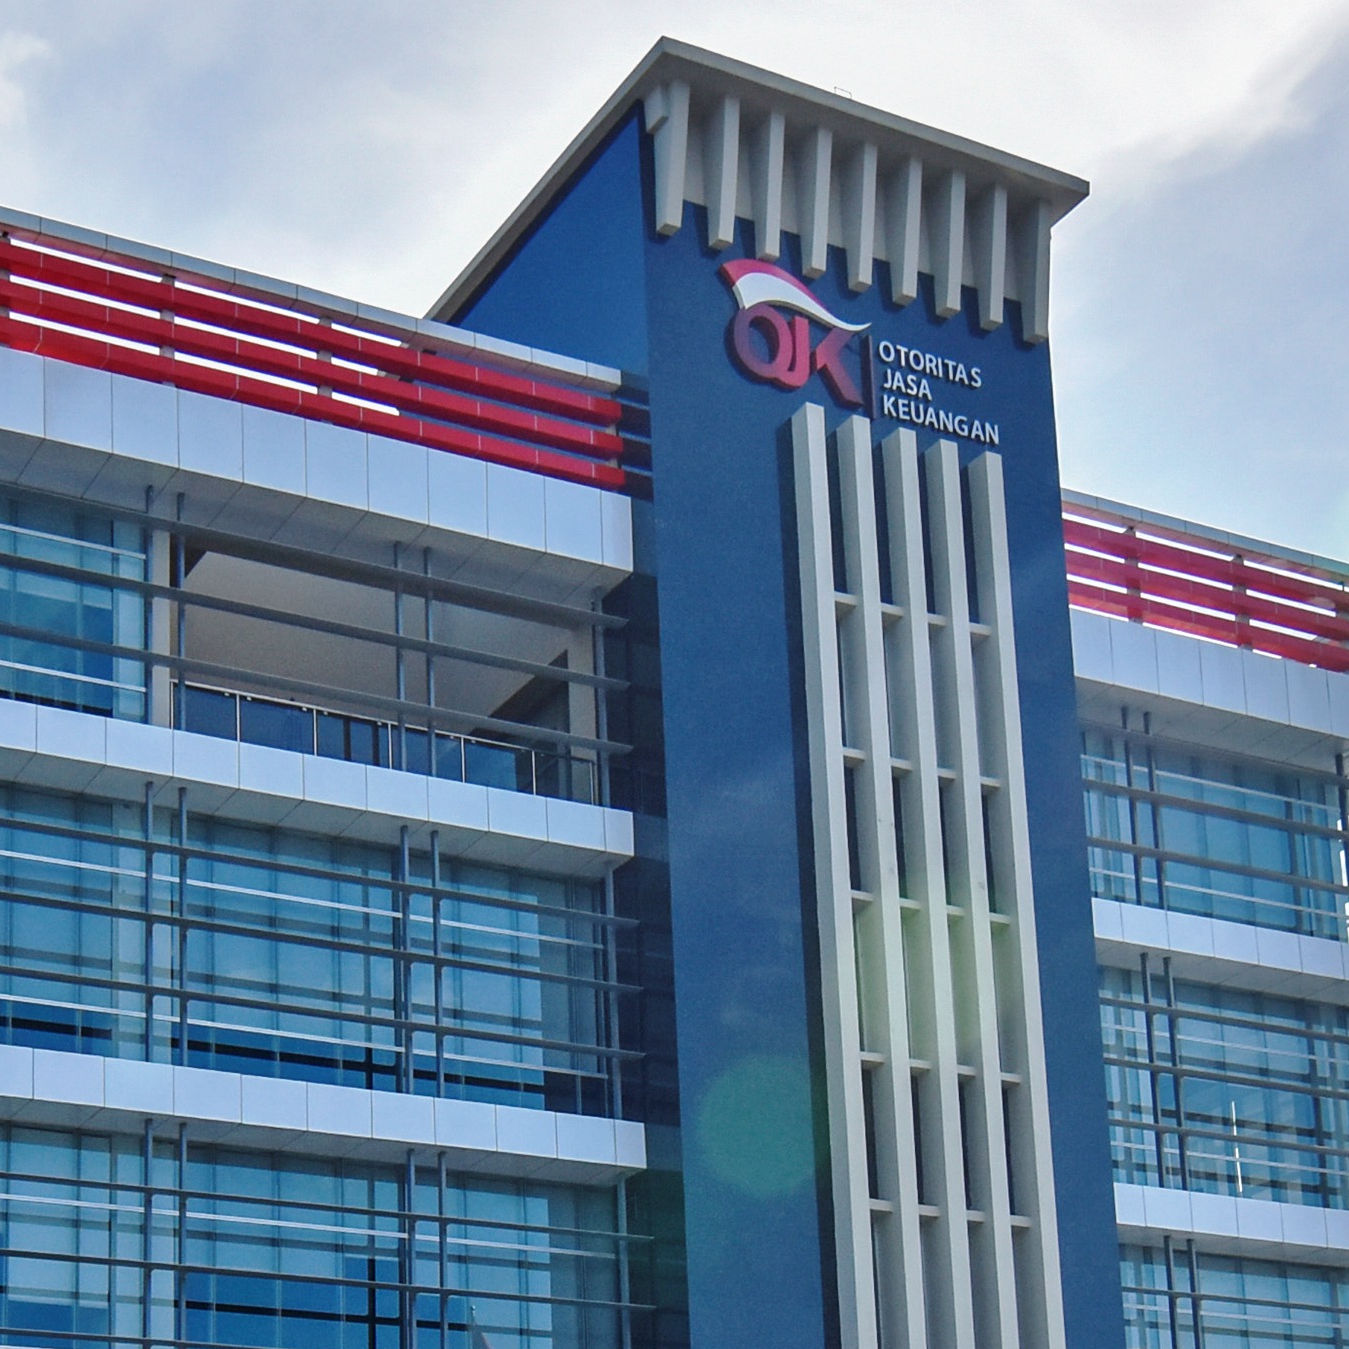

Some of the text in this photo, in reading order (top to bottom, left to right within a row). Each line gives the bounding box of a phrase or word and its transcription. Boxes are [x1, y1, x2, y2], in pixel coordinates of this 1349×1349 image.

[726, 303, 864, 408] OJK
[879, 341, 982, 388] OTORITAS
[883, 369, 932, 401] JASA
[883, 394, 999, 445] KEUANGAN
